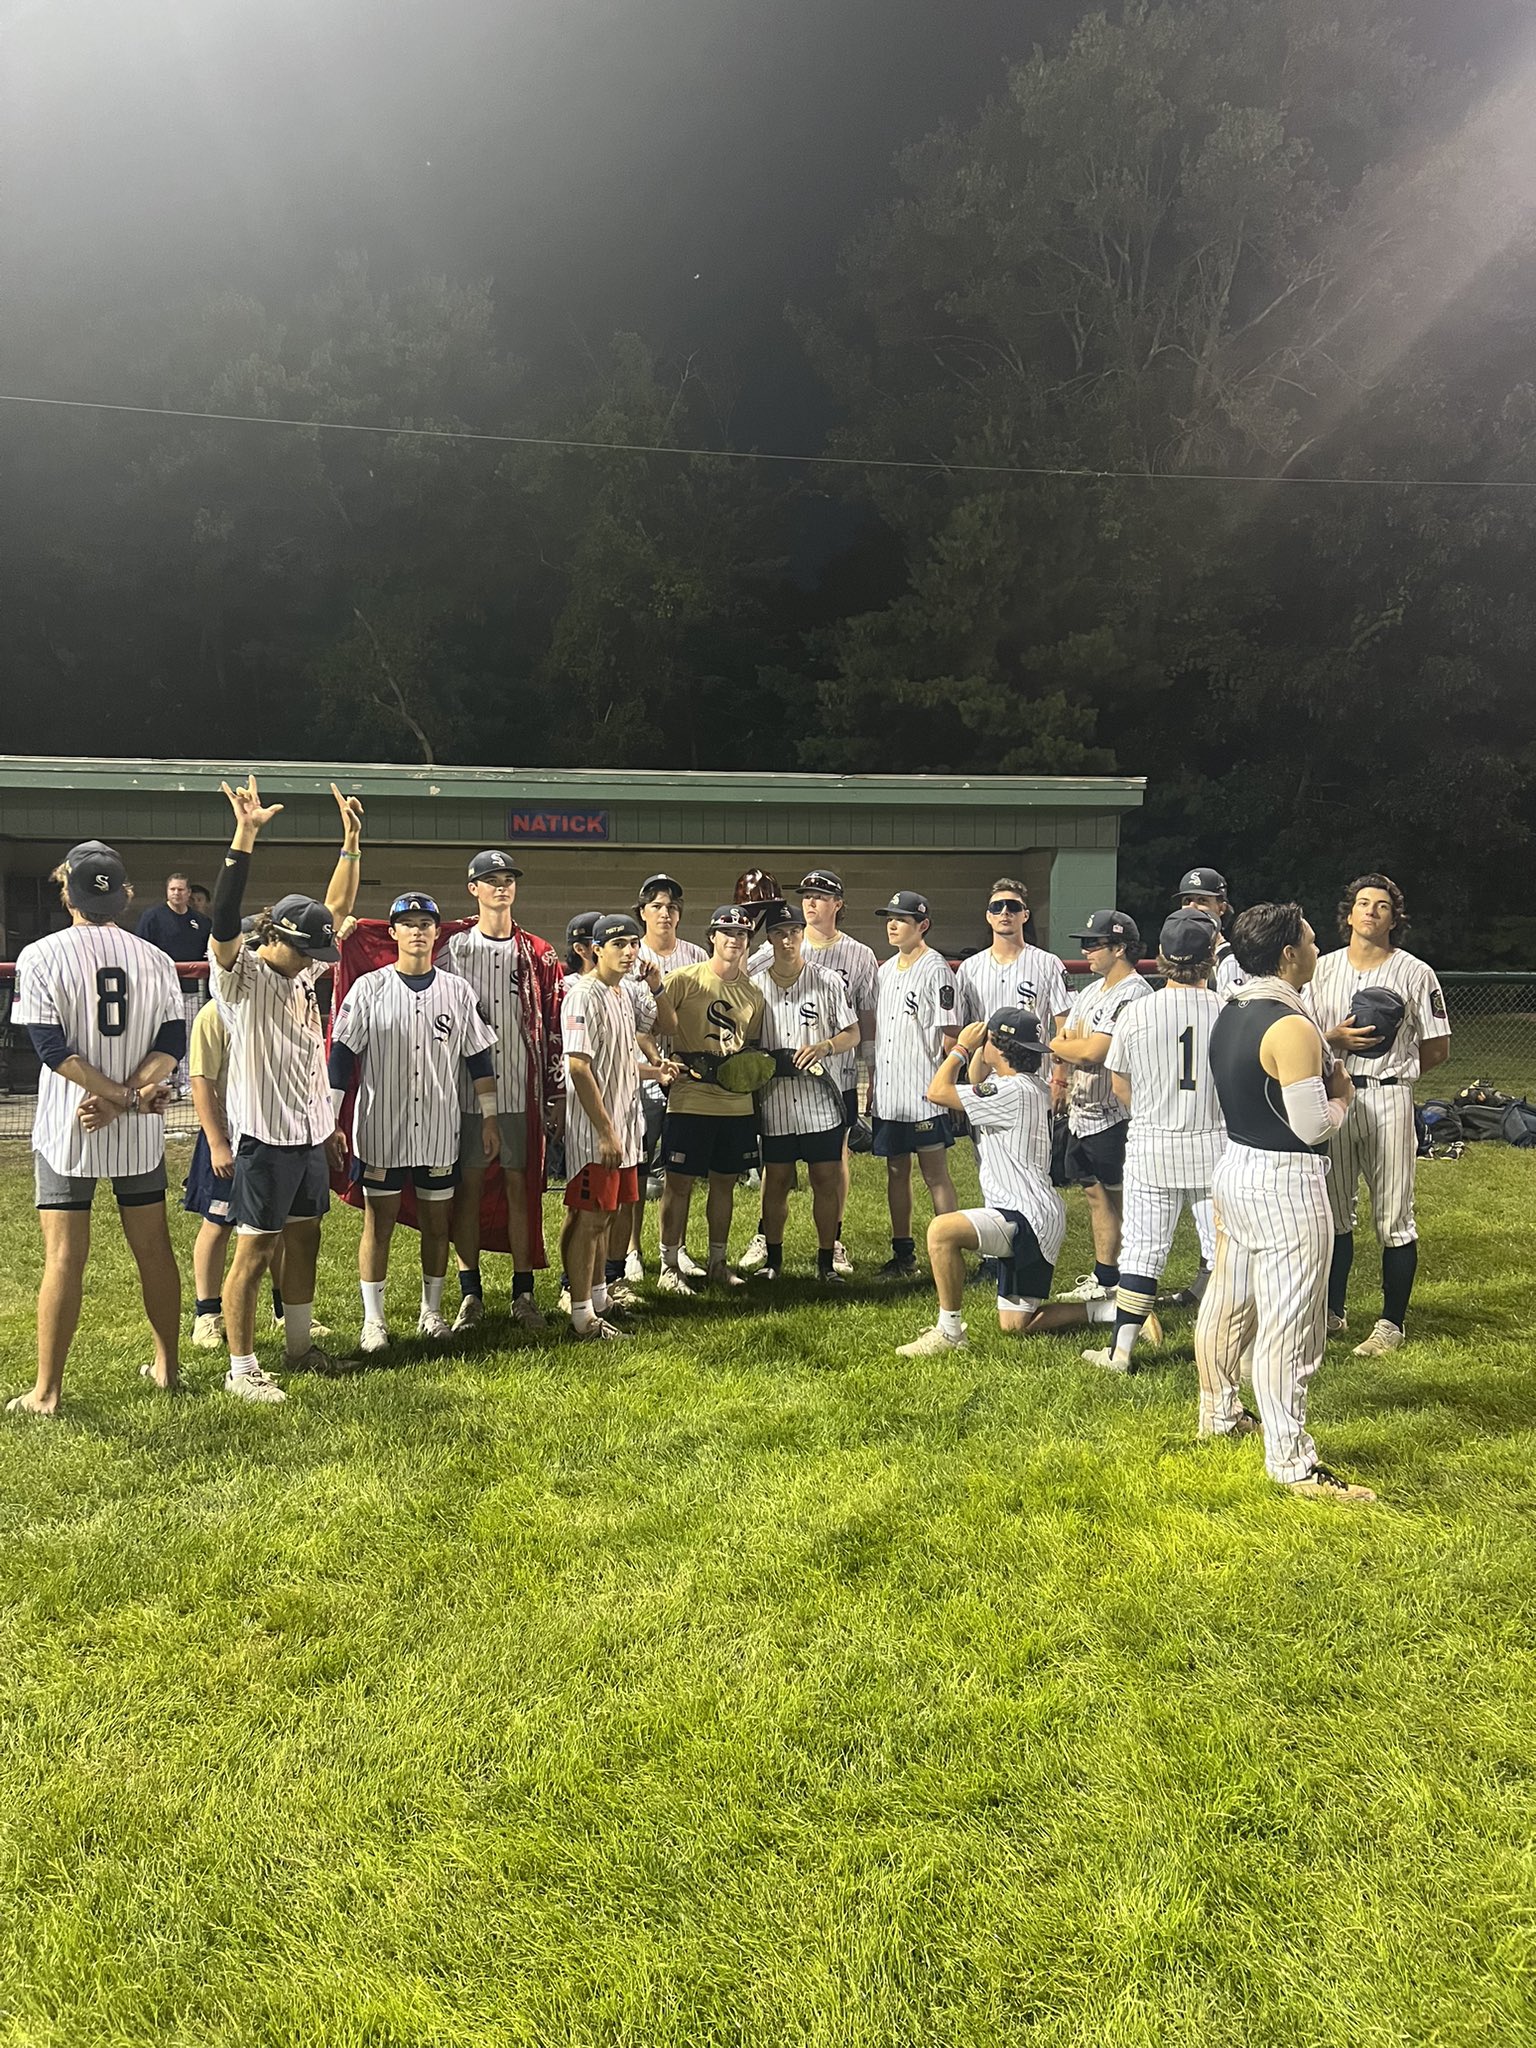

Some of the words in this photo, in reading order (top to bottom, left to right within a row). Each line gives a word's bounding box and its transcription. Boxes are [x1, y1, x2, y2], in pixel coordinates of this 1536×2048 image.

[512, 815, 604, 833] NATICK
[489, 853, 506, 867] S
[94, 875, 110, 892] S
[1188, 872, 1202, 886] S
[190, 919, 200, 930] S
[96, 967, 127, 1036] 8
[903, 991, 919, 1016] S
[1017, 981, 1038, 1007] S
[704, 1000, 737, 1042] S
[799, 1002, 820, 1028] S
[432, 1014, 453, 1043] S
[1179, 1025, 1196, 1091] 1
